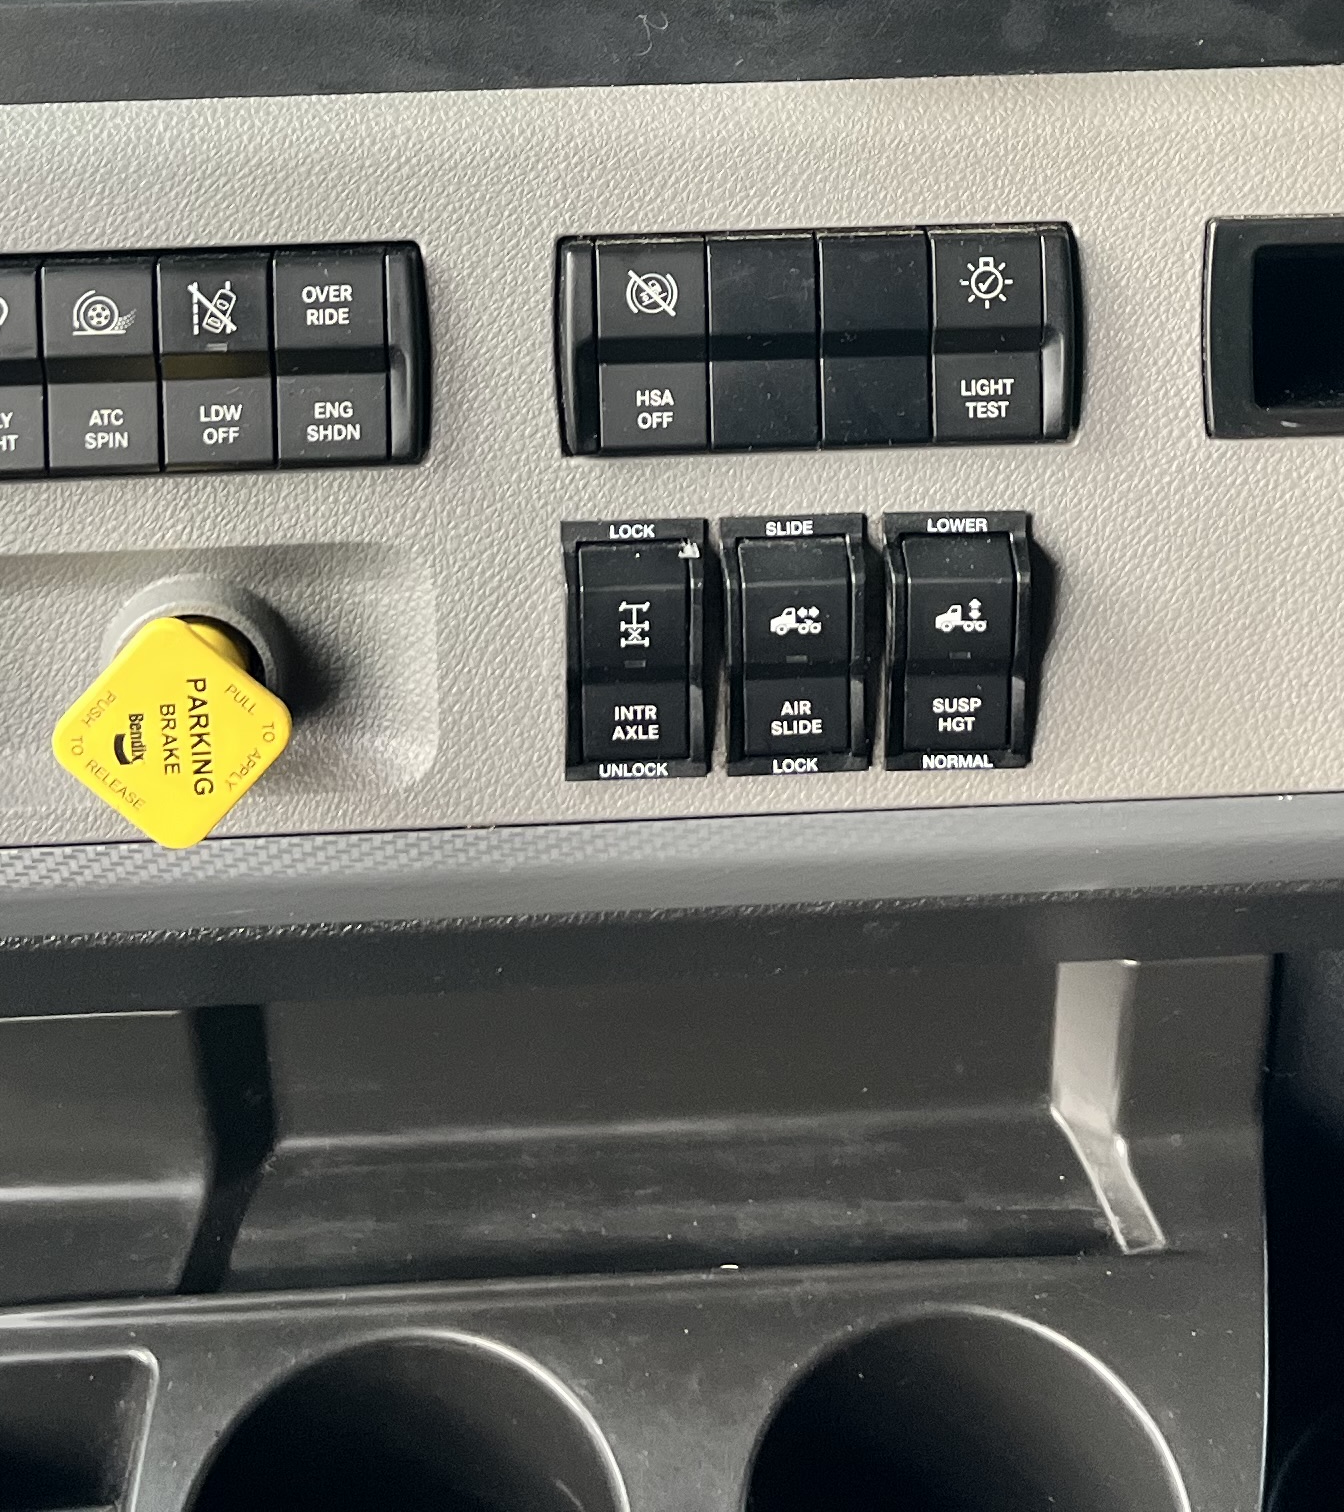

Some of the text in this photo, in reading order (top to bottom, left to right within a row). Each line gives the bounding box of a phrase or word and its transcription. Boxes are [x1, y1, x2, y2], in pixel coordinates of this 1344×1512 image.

[301, 285, 353, 306] OVER
[306, 305, 350, 326] RIDE
[960, 378, 1014, 398] LIGHT
[636, 389, 674, 407] HSA
[88, 408, 125, 429] ATC
[198, 404, 243, 424] LDW
[314, 401, 354, 421] ENG
[965, 400, 1010, 419] TEST
[637, 412, 674, 429] OFF
[84, 429, 129, 450] SPIN
[203, 425, 241, 446] OFF
[306, 421, 362, 443] SHDN
[609, 523, 656, 539] LOCK
[765, 520, 814, 537] SLIDE
[926, 518, 988, 534] LOWER
[614, 705, 657, 721] INTR
[780, 700, 812, 717] AIR
[931, 697, 982, 714] SUSP
[612, 724, 660, 741] AXLE
[770, 719, 823, 736] SLIDE
[938, 716, 976, 733] HGT
[128, 713, 147, 763] Bendix
[159, 703, 181, 776] BRAKE
[186, 677, 214, 796] PARKING
[223, 683, 276, 792] PULL TO APPLY
[70, 690, 146, 812] PUSH TO RELEASE
[598, 761, 669, 778] UNLOCK
[772, 757, 819, 774] LOCK
[922, 753, 994, 770] NORMAL
